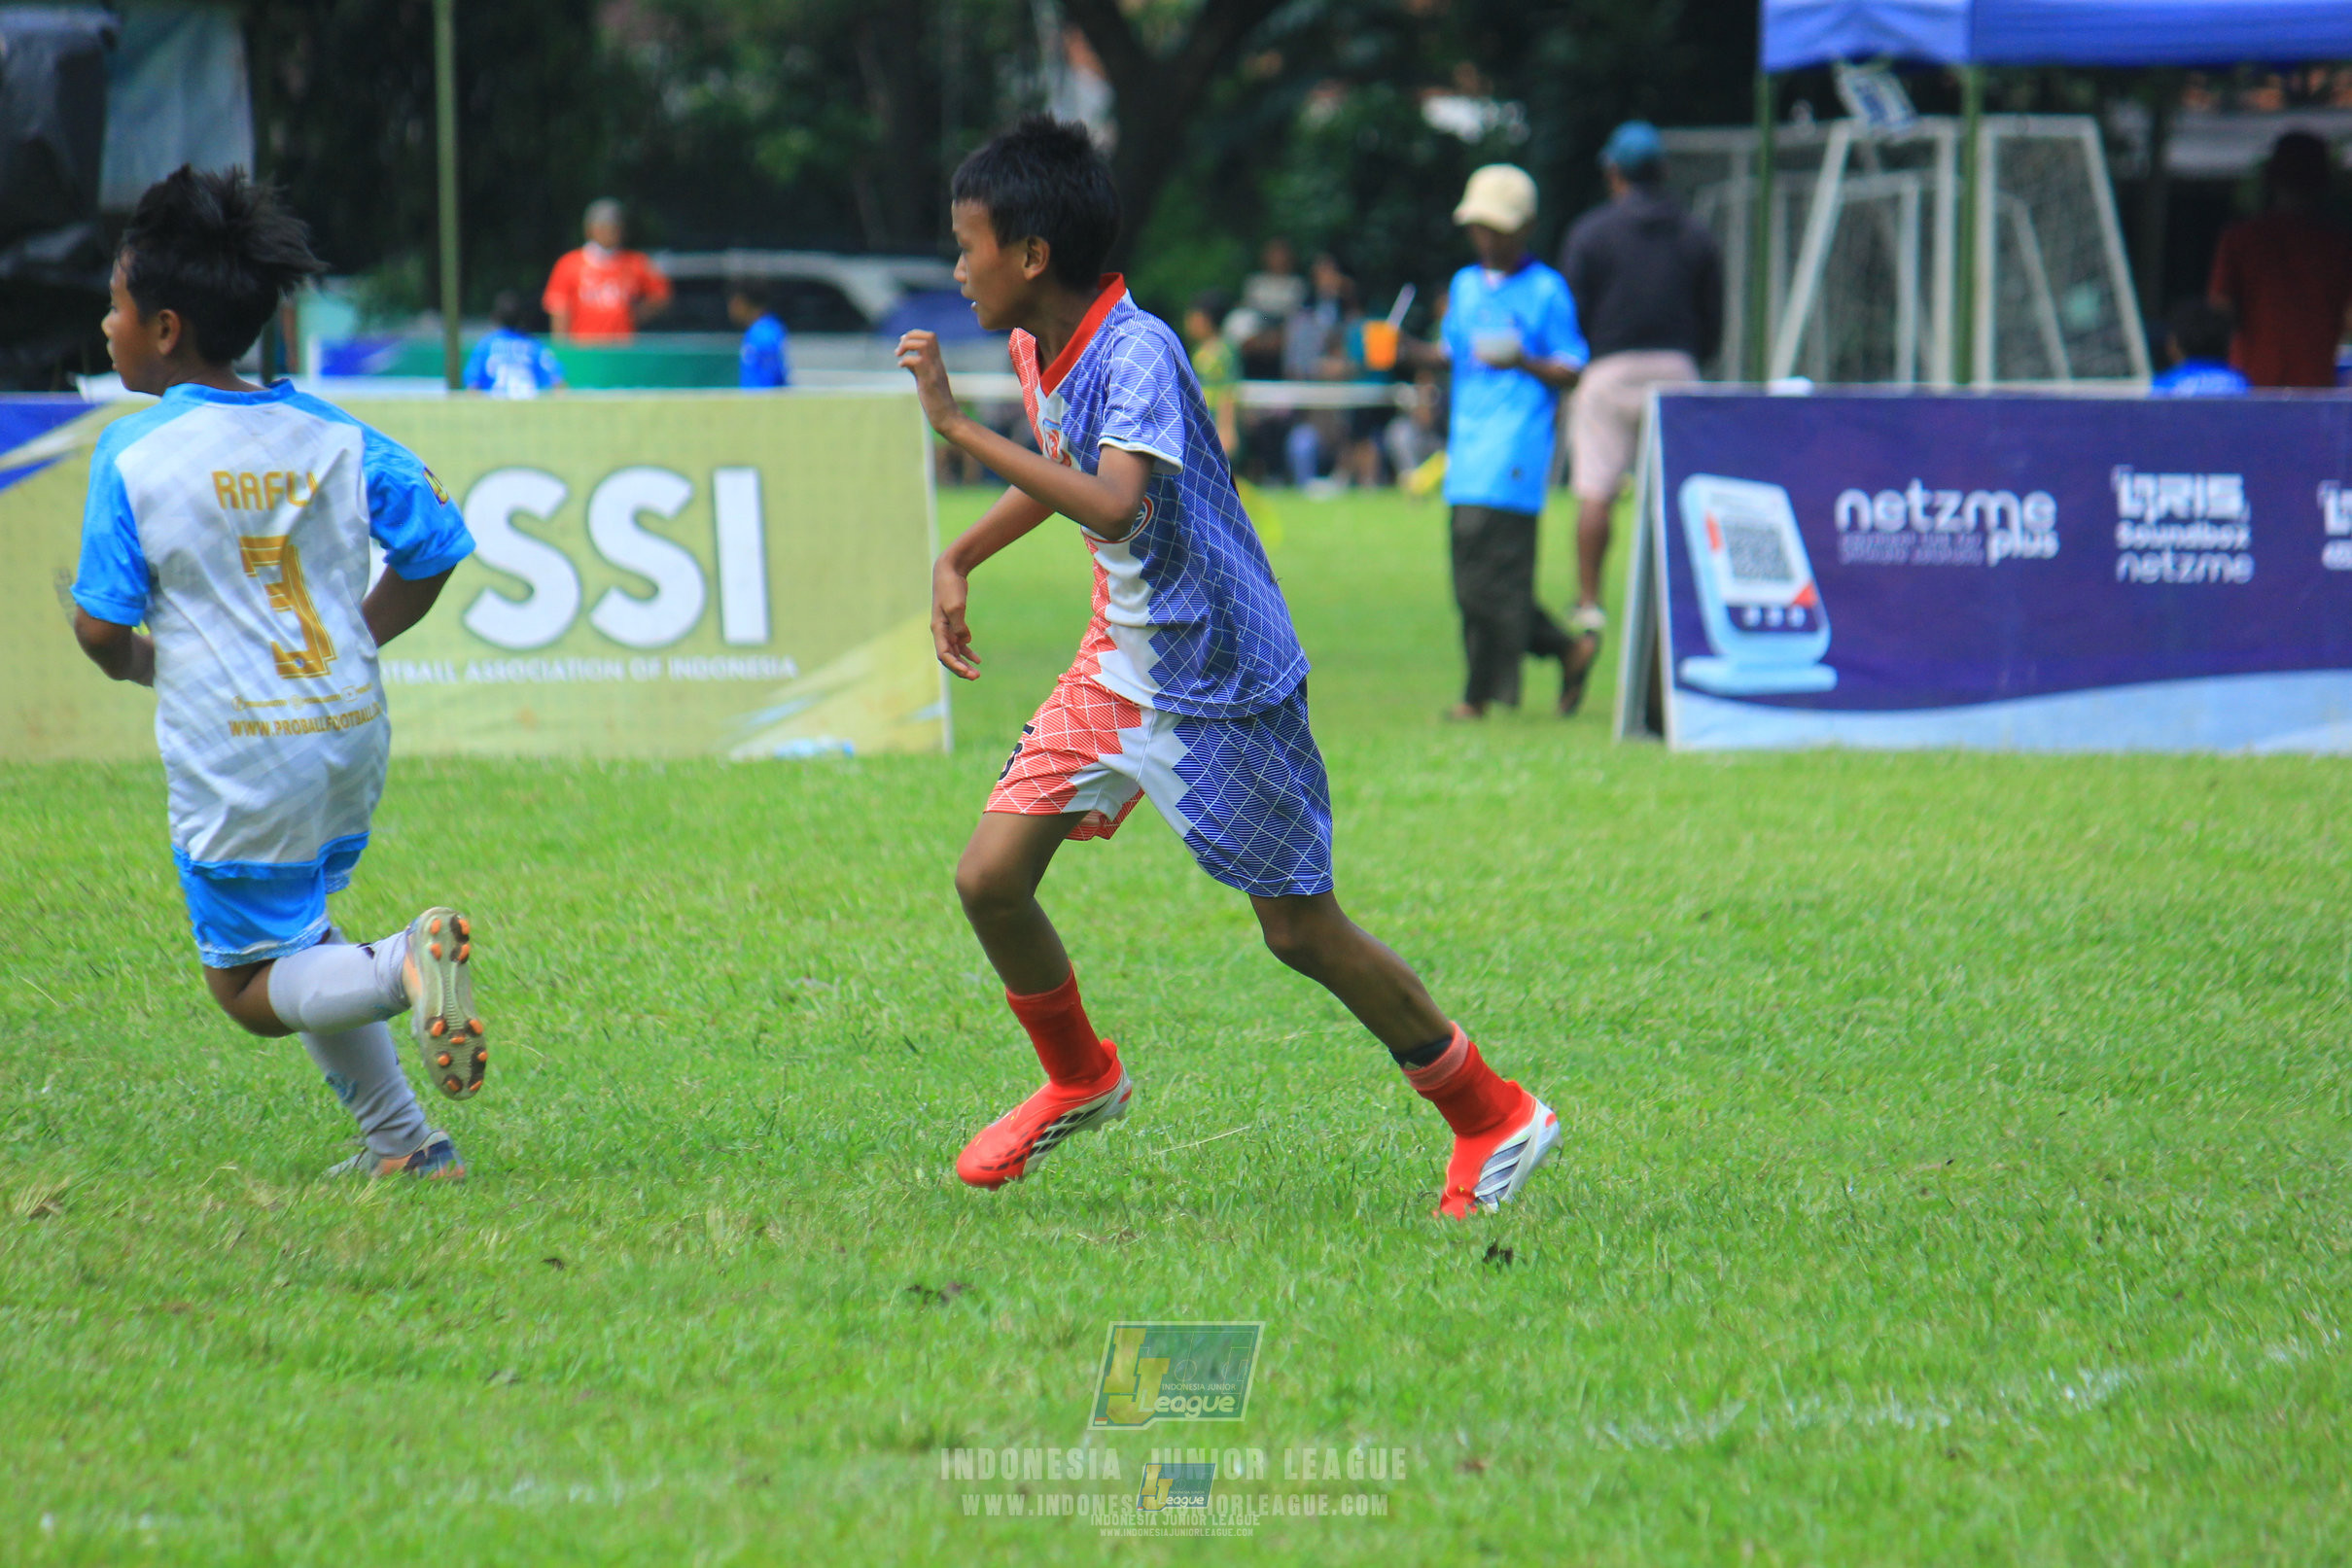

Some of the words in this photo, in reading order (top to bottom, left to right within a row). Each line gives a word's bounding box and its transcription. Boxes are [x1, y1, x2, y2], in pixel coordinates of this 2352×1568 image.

[1834, 476, 2057, 534] netzme
[463, 466, 770, 650] SSI
[1986, 528, 2060, 568] plus
[2115, 549, 2255, 583] netzme
[239, 535, 337, 679] 3
[465, 657, 625, 685] ASSOCIATION
[628, 655, 662, 683] OF
[667, 653, 798, 681] INDONESIA
